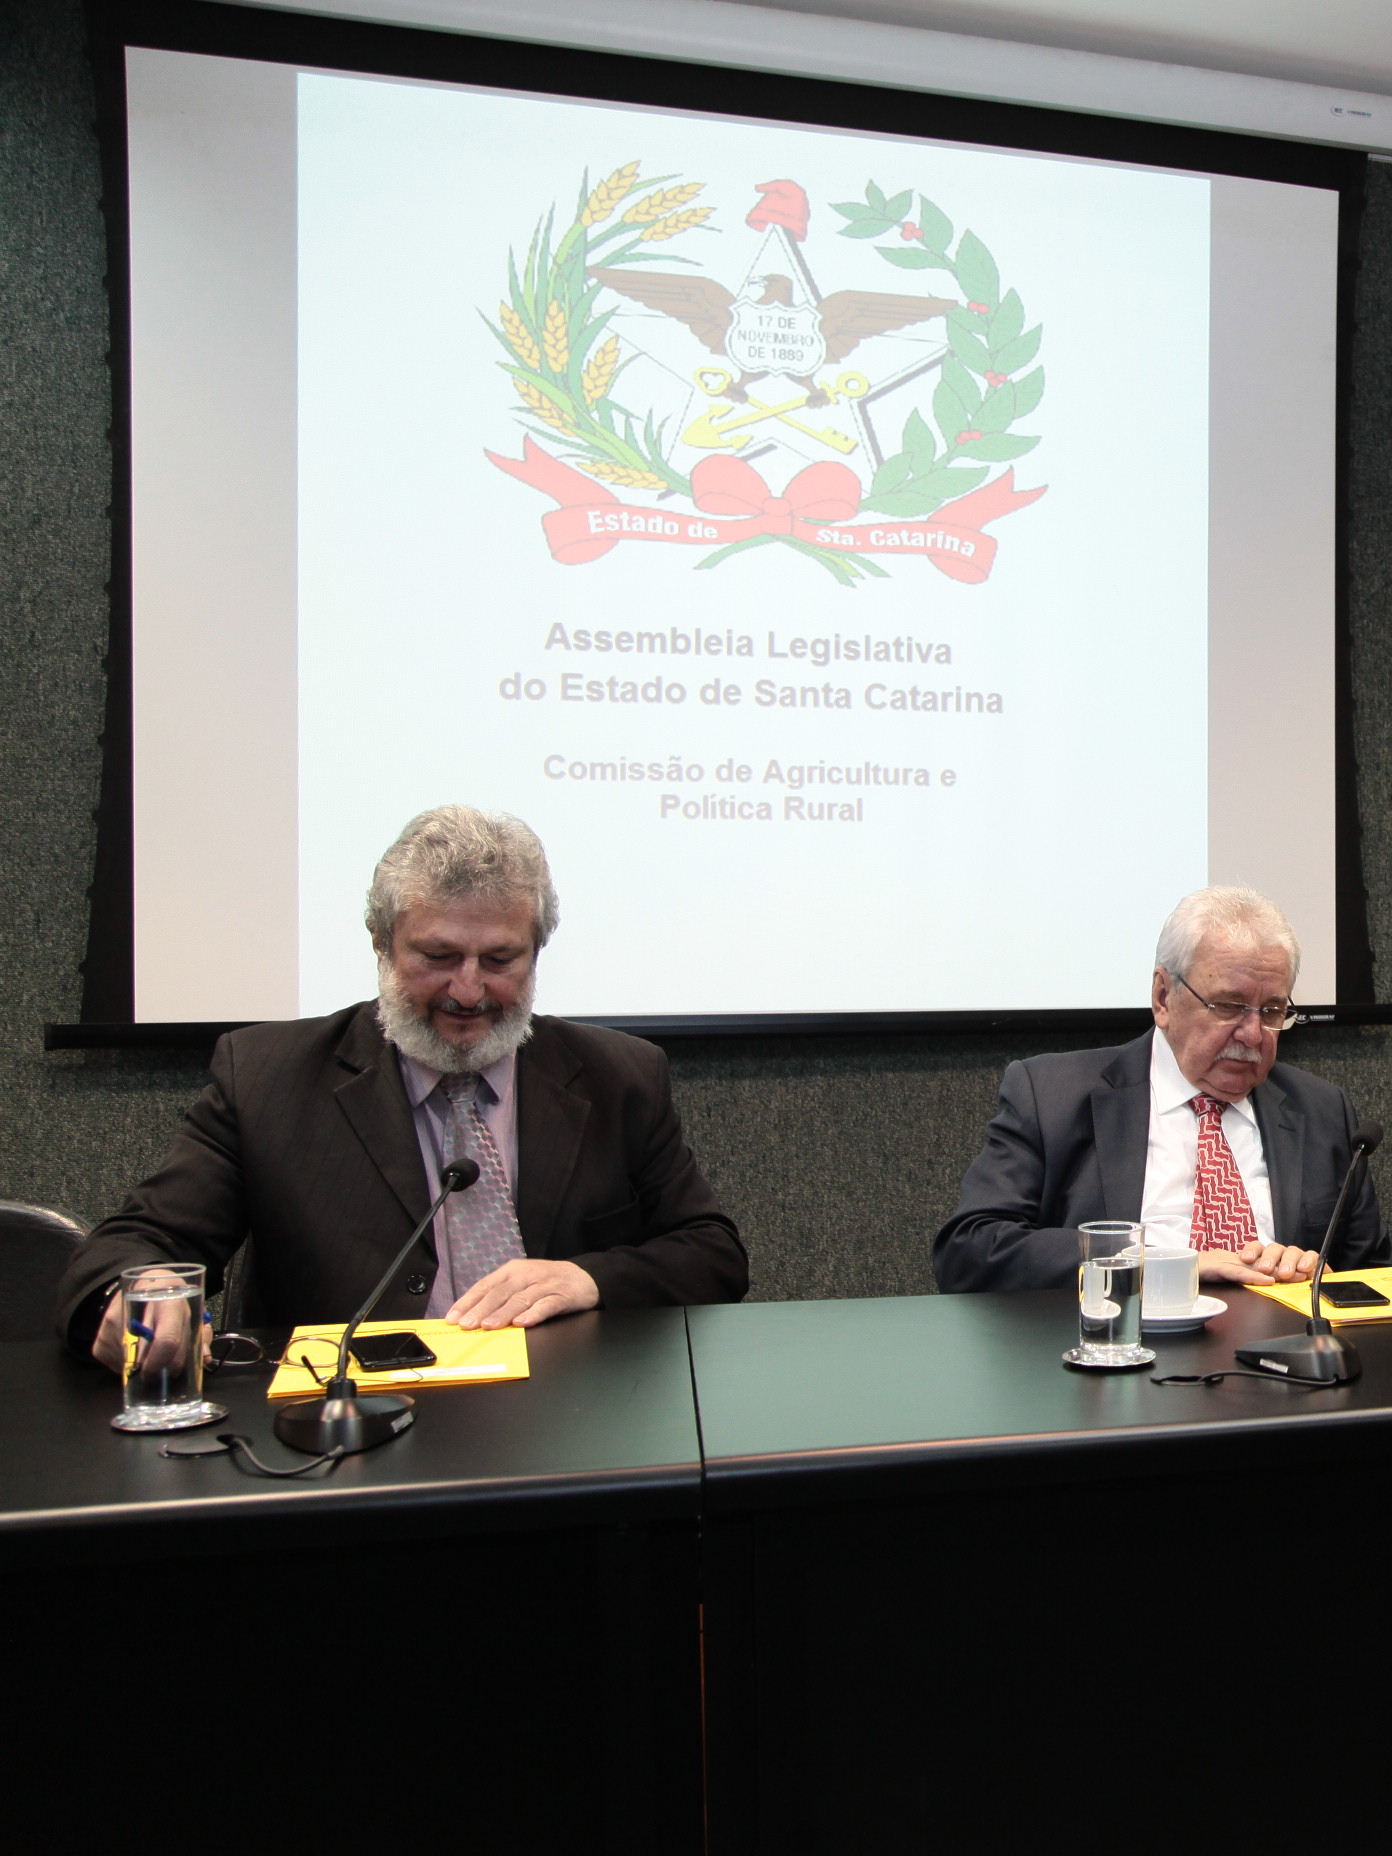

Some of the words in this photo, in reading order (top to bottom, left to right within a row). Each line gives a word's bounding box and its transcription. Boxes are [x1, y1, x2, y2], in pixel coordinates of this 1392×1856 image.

[758, 315, 774, 326] 17
[778, 316, 797, 329] DE
[737, 330, 815, 347] NOVEMBRO
[748, 346, 766, 358] DE
[771, 348, 804, 361] 1889
[587, 510, 680, 536] Estado
[687, 520, 719, 539] de
[815, 529, 862, 546] Sta.
[870, 530, 977, 557] Catarina
[543, 622, 754, 658] Assembleia
[767, 630, 952, 667] Legislativa
[498, 672, 547, 701] do
[560, 672, 687, 704] Estado
[699, 677, 742, 706] de
[754, 678, 852, 710] Santa
[864, 682, 1004, 714] Catarina
[543, 754, 704, 783] Comissão
[715, 758, 753, 784] de
[762, 759, 930, 790] Agricultura
[940, 768, 957, 787] e
[660, 793, 773, 821] Política
[783, 796, 863, 822] Rural
